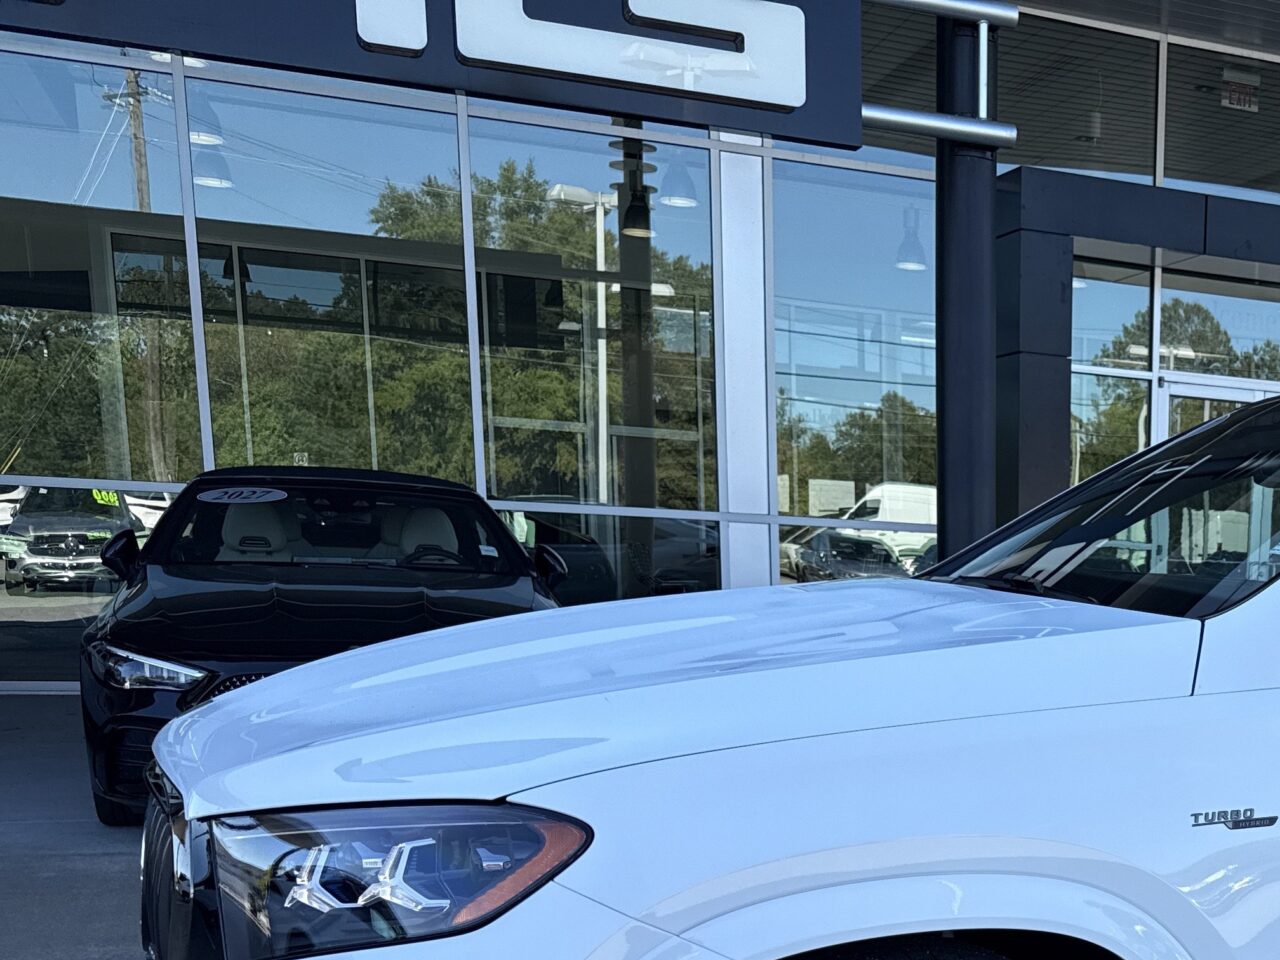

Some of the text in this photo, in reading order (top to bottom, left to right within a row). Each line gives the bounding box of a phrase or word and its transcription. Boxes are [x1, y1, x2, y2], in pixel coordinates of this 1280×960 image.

[211, 490, 273, 500] 2027
[1190, 808, 1255, 823] TURBO
[1239, 819, 1270, 828] HYBRID
